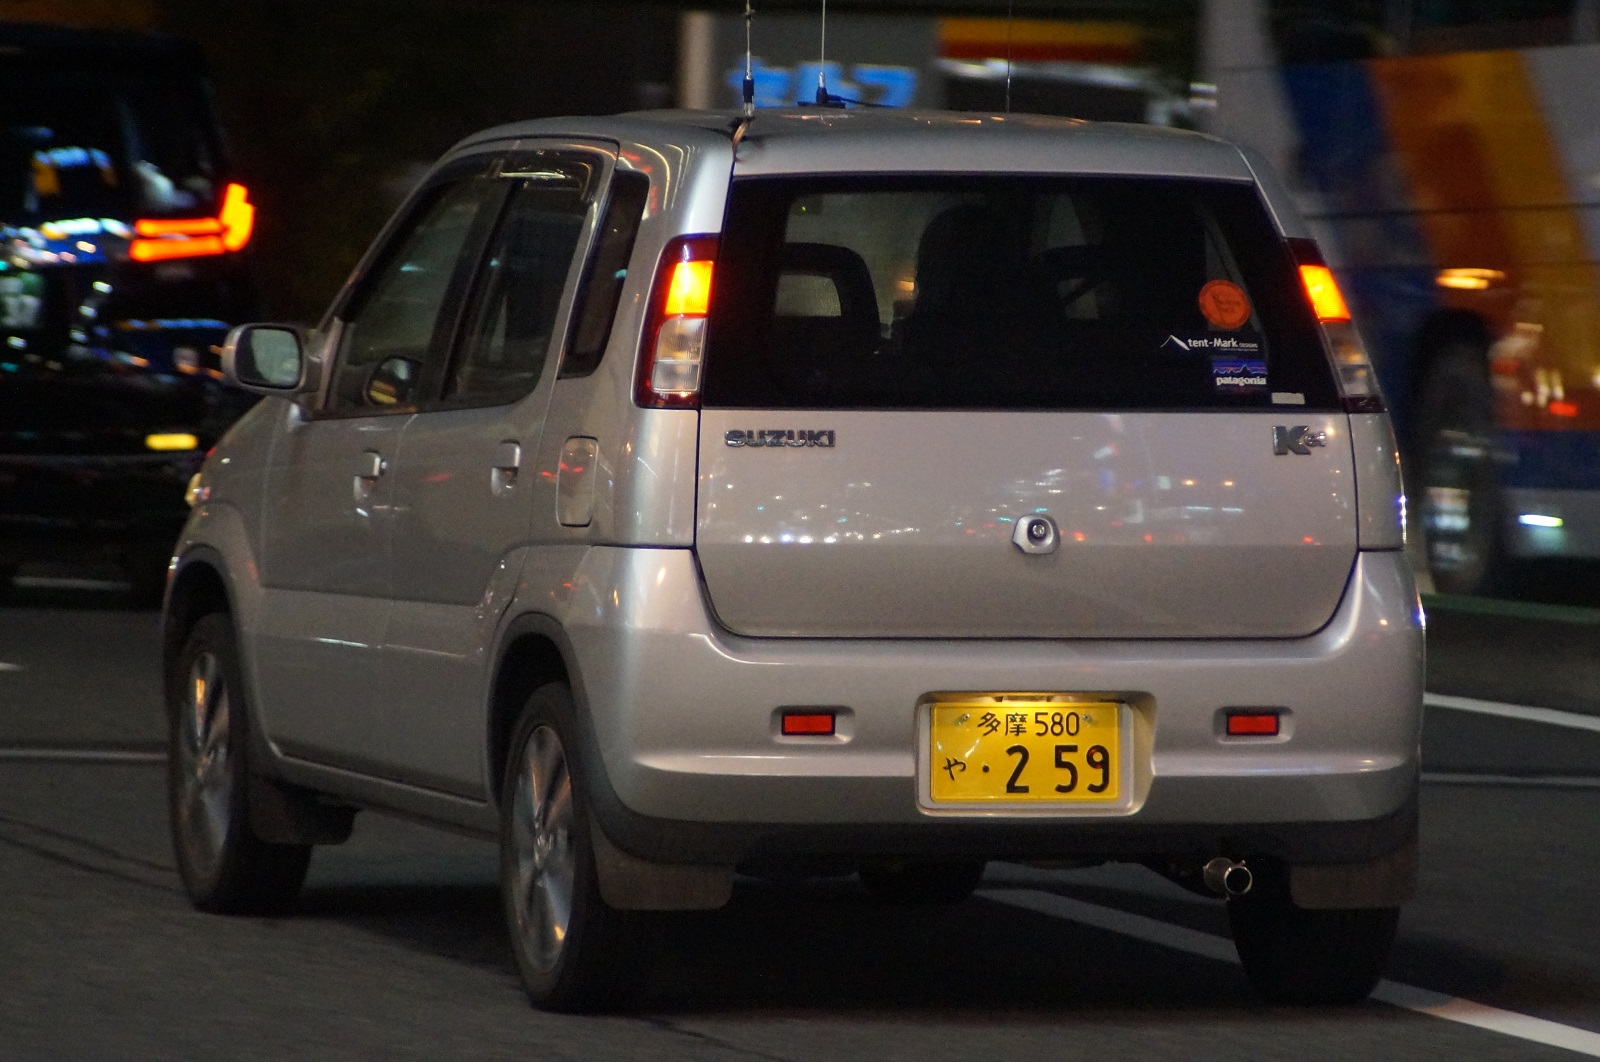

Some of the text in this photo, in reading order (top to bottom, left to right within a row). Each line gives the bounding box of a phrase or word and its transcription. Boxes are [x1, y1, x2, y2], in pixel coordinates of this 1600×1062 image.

[1187, 337, 1238, 348] tent-Mark
[1216, 376, 1267, 386] patagonia
[725, 429, 835, 447] SUZUKI
[977, 711, 1080, 737] 多摩 580
[943, 757, 967, 781] や
